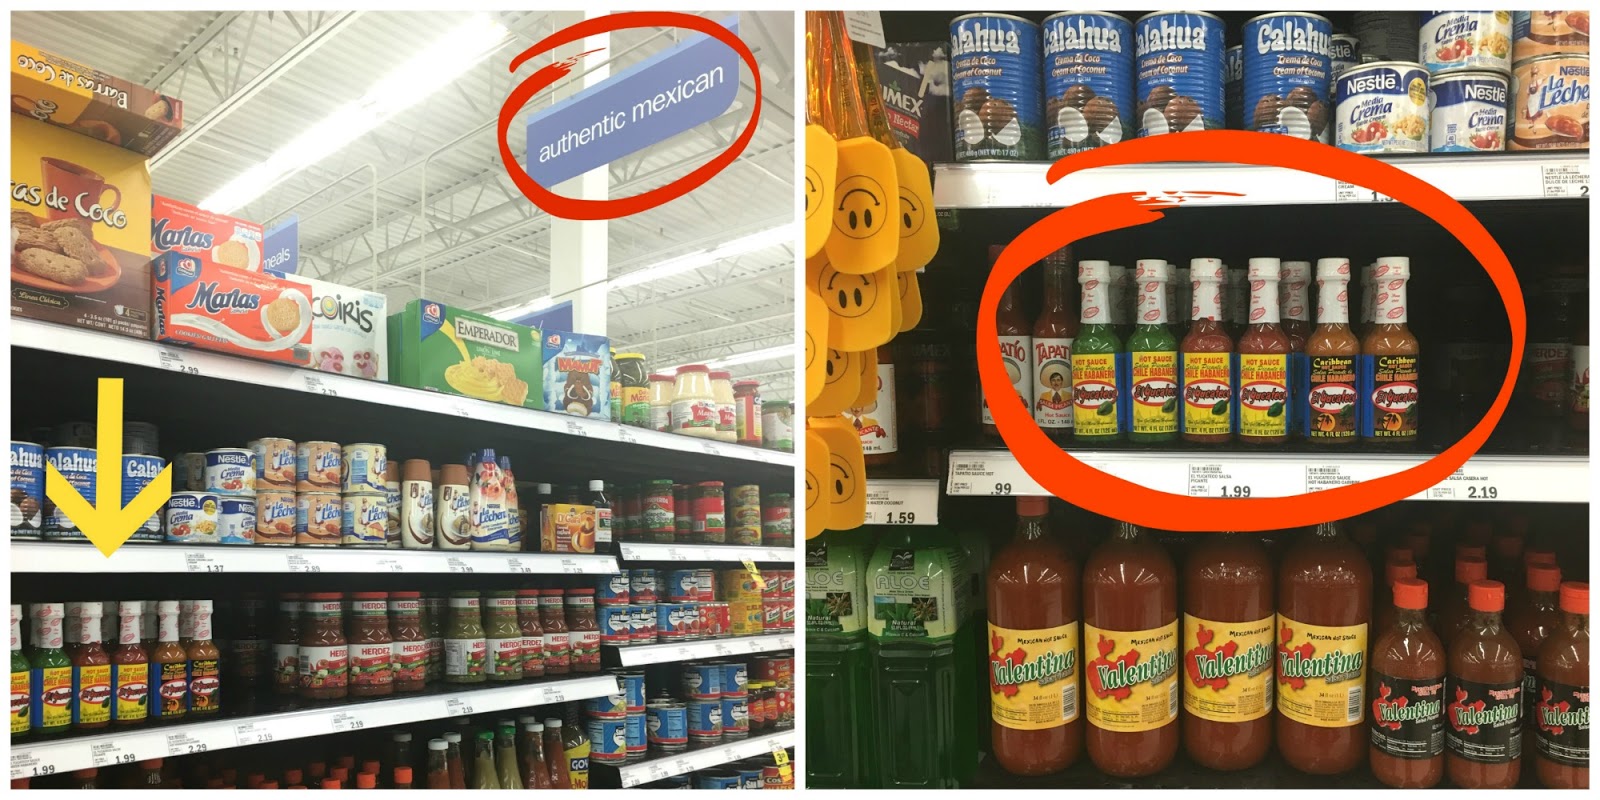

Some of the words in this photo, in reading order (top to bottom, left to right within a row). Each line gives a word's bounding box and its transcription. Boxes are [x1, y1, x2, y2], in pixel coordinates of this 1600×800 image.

[1447, 15, 1470, 27] Media
[1435, 19, 1478, 44] Crema
[1084, 53, 1101, 63] Coco
[1166, 53, 1183, 64] Coco
[1310, 57, 1323, 67] Coco
[974, 67, 1003, 77] Coconut
[1078, 65, 1107, 75] Coconut
[1161, 64, 1189, 75] Coconut
[1273, 66, 1295, 76] Cream
[1549, 75, 1564, 91] La
[1361, 97, 1384, 108] Media
[538, 110, 626, 163] authentic
[632, 66, 724, 123] mexican
[1350, 102, 1393, 125] Crema
[1468, 111, 1504, 129] Crema
[11, 181, 42, 205] as
[46, 186, 69, 211] de
[74, 191, 128, 229] Coco
[457, 320, 518, 348] EMPERADOR
[1313, 357, 1352, 368] Caribbean
[180, 365, 199, 375] 2.99
[1133, 368, 1149, 377] CHILE
[1221, 485, 1251, 498] 1.99
[1468, 486, 1498, 499] 2.19
[886, 511, 915, 524] 1.59
[806, 571, 844, 586] LOE
[875, 575, 930, 590] ALOE
[1017, 637, 1042, 645] MEXICAN
[1131, 638, 1155, 646] MEXICAN
[1306, 632, 1332, 641] MEXICAN
[361, 647, 391, 656] HERDEZ
[992, 648, 1075, 686] Valentina
[1280, 649, 1363, 678] Valentina
[1378, 699, 1441, 722] Valentina
[1455, 703, 1519, 726] Valentina
[1542, 706, 1590, 726] Valenti
[188, 743, 208, 754] 2.29
[115, 753, 136, 764] 1.99
[33, 764, 55, 777] 1.99
